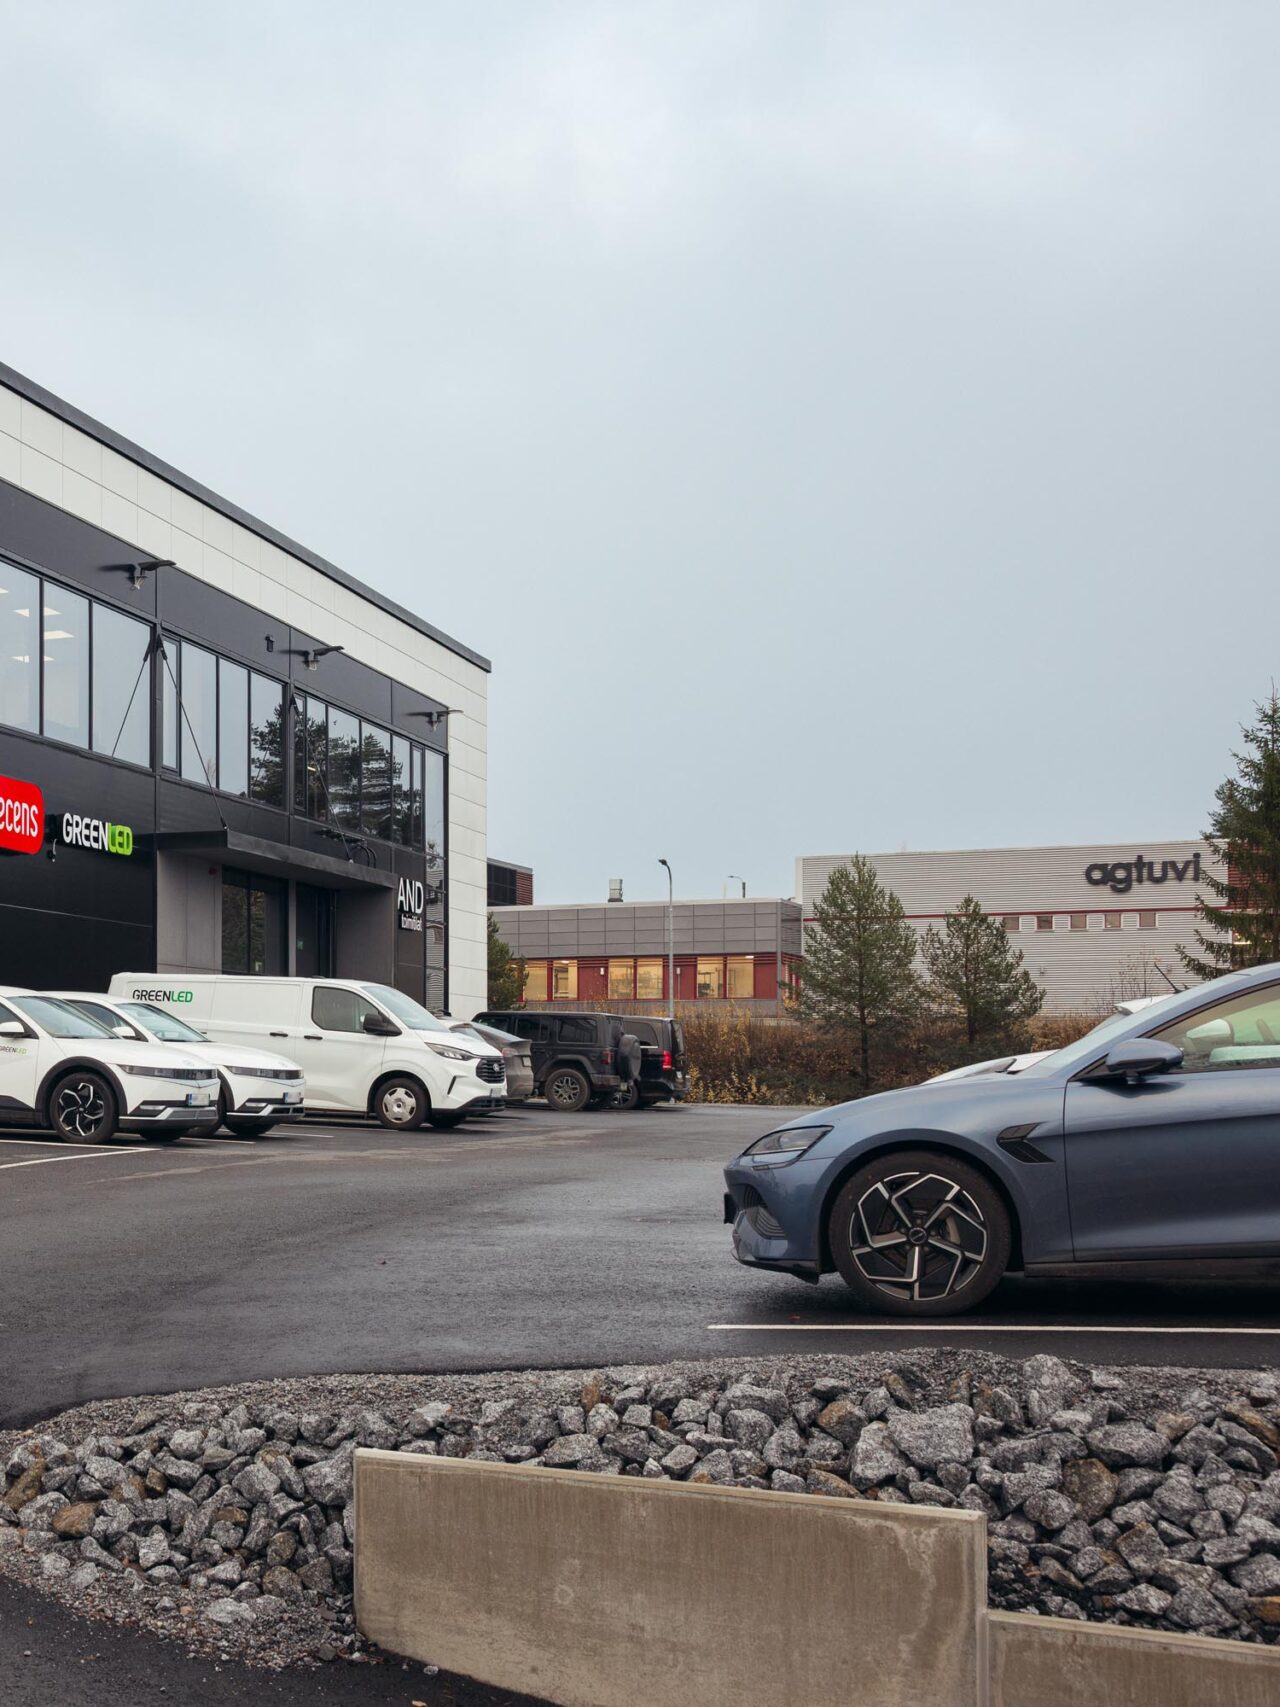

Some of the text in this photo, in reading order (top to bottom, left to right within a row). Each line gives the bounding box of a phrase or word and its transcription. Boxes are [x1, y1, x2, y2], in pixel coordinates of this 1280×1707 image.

[62, 812, 133, 856] GREENLED
[1085, 852, 1200, 892] agtuvi
[397, 876, 424, 914] AND
[132, 989, 194, 1003] GREENLED
